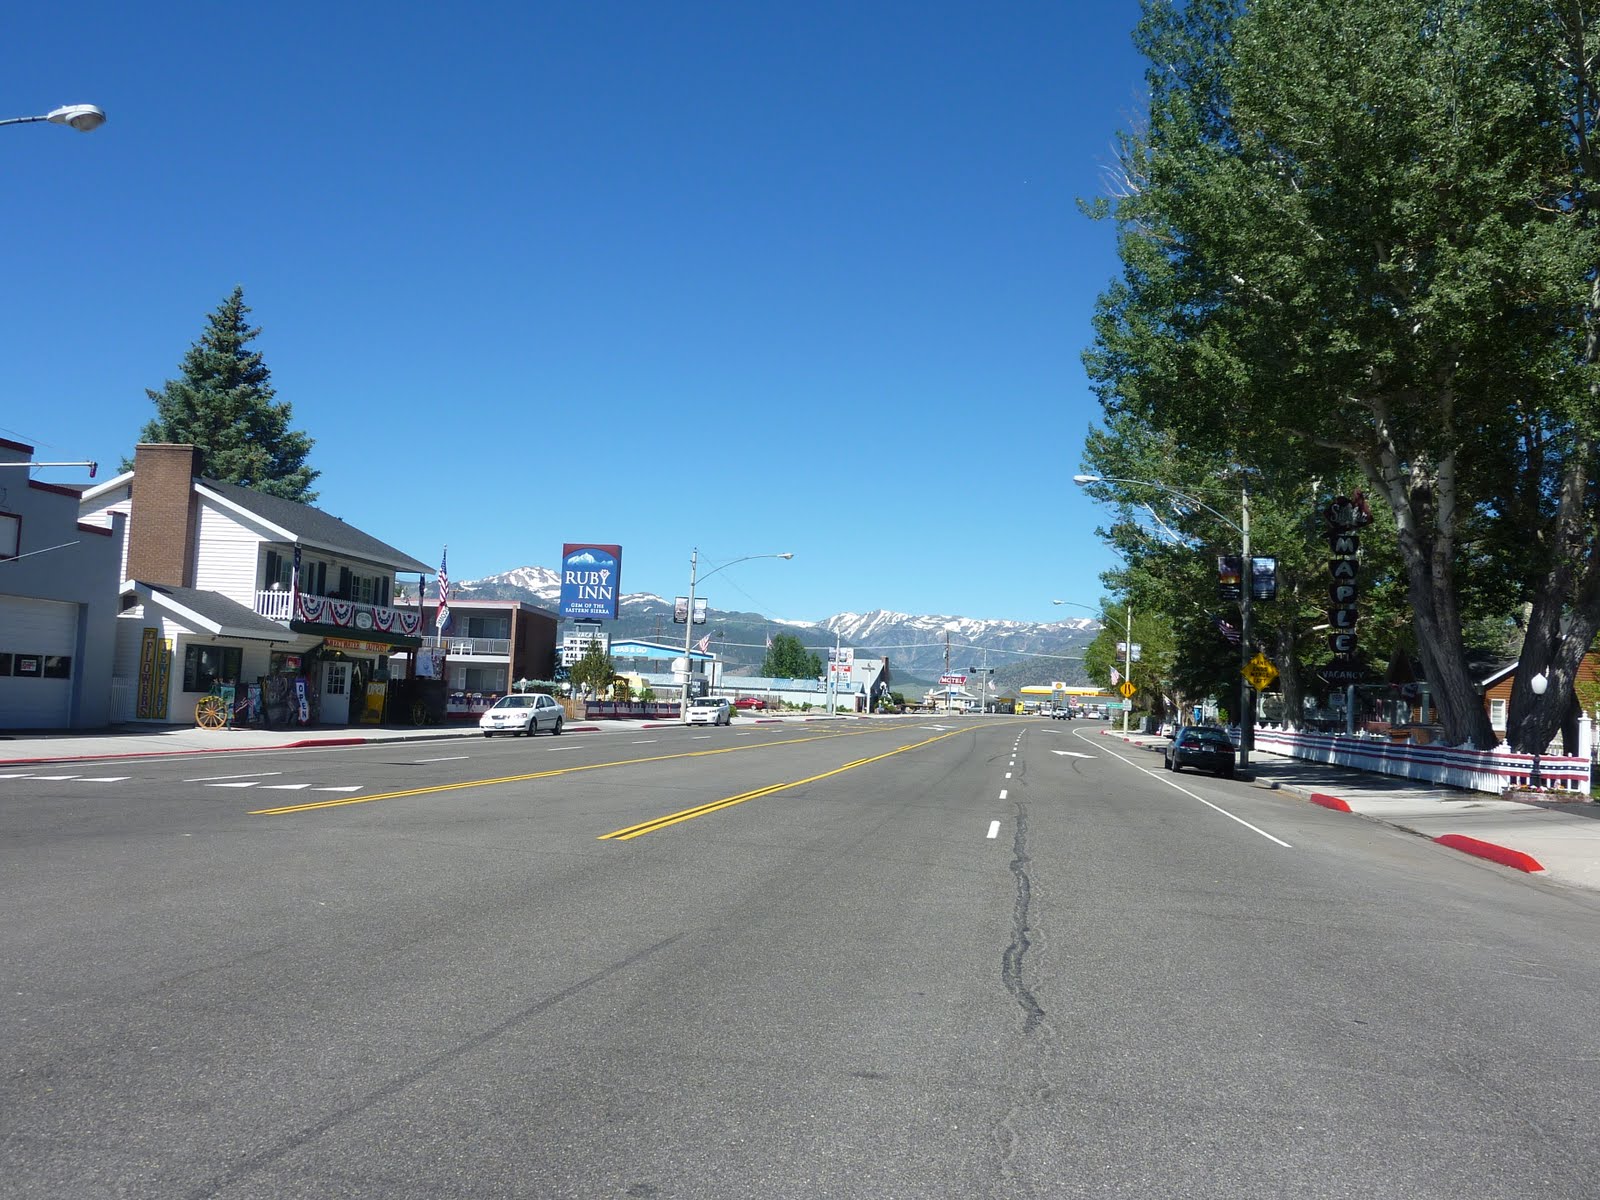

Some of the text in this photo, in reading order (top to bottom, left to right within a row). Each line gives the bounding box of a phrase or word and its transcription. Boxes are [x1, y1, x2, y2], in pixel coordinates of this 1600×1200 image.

[565, 569, 611, 585] RUBY
[578, 585, 613, 600] INN
[1335, 537, 1354, 650] MAPLE
[139, 640, 153, 716] FLOWERS
[1322, 671, 1365, 679] VACANCY
[298, 684, 307, 718] OPEN
